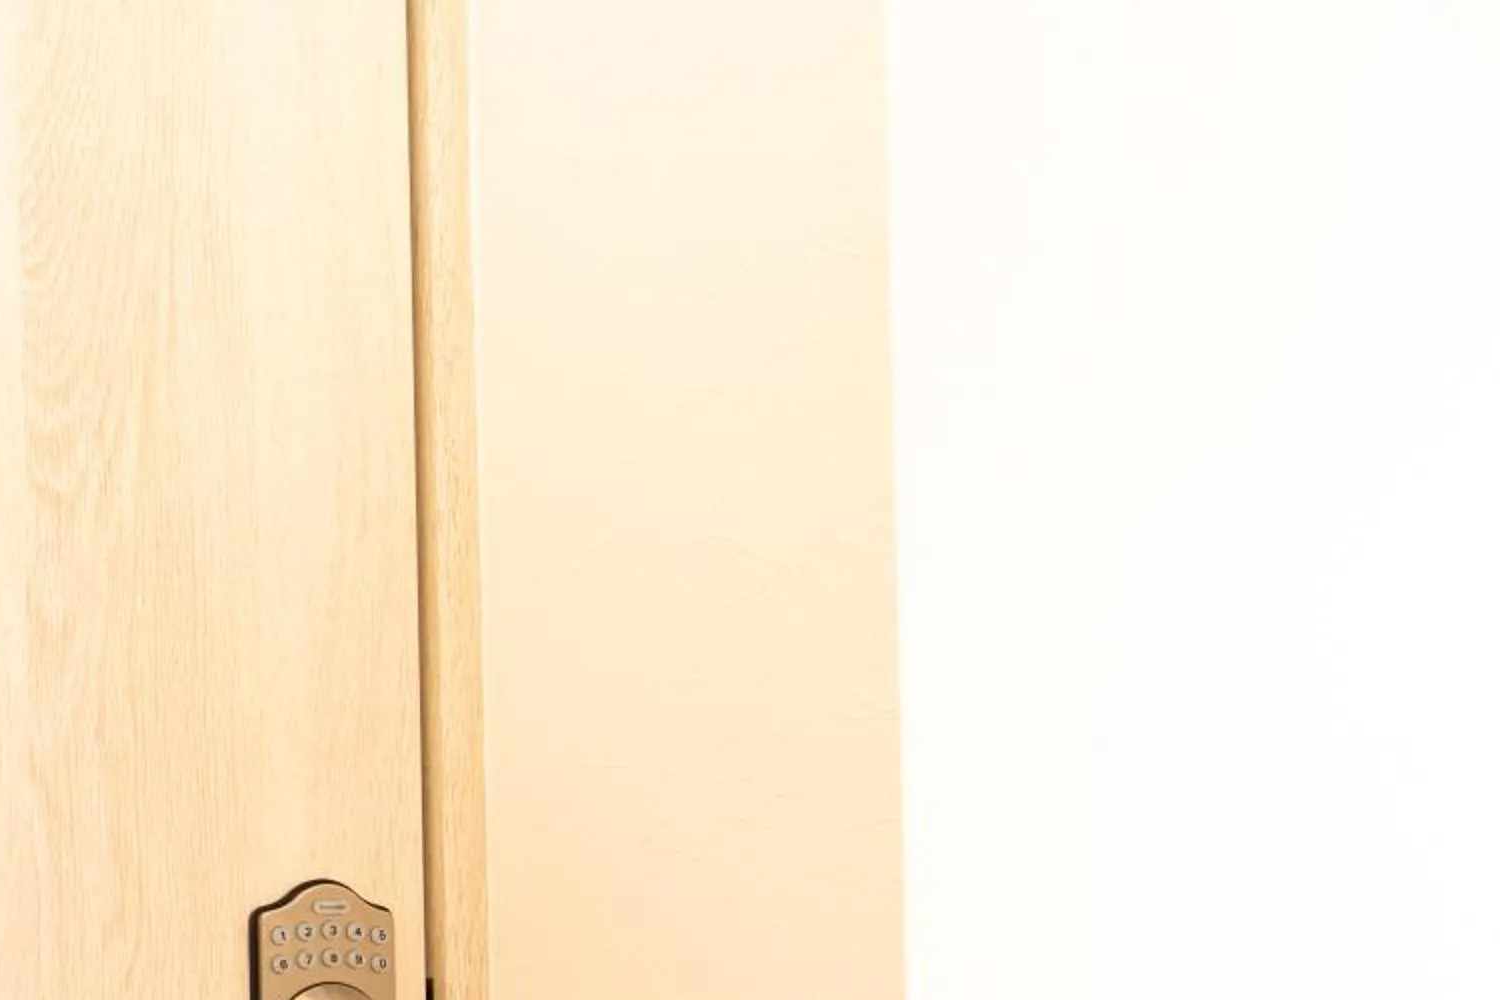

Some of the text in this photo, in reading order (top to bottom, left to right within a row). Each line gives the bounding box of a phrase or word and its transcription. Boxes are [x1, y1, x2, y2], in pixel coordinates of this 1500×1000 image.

[305, 927, 312, 937] 2
[354, 927, 362, 936] 4
[379, 929, 387, 940] 5
[279, 959, 288, 969] 6
[330, 954, 337, 963] 8
[355, 954, 362, 964] 9
[379, 958, 387, 969] 0
